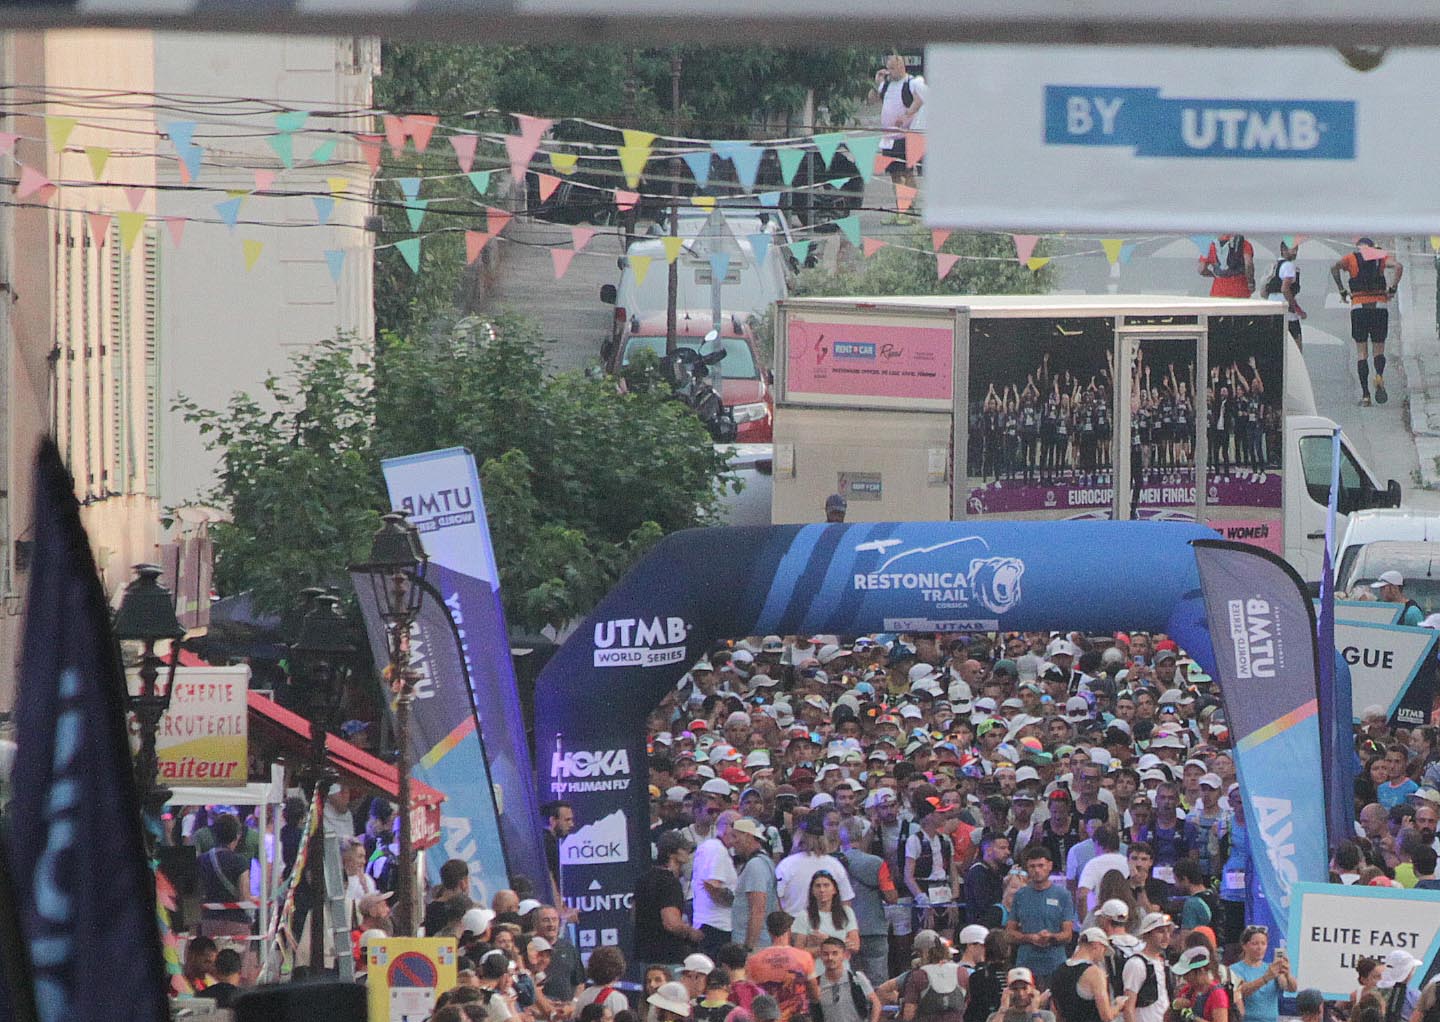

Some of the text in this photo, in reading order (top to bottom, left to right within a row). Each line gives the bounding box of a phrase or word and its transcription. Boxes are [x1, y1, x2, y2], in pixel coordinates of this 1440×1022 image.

[1065, 95, 1322, 151] BY UTMB
[1068, 488, 1114, 505] EUROCUP
[1162, 488, 1196, 504] FINALS
[853, 571, 968, 590] RESTONICA
[921, 589, 969, 602] TRAIL
[593, 615, 687, 649] UTMB
[893, 621, 912, 630] BY
[600, 650, 683, 663] WORLD SERIES
[157, 757, 238, 778] raiteur
[550, 749, 631, 778] HOKA
[568, 780, 613, 793] HUMAN
[613, 778, 631, 790] FLY
[567, 840, 621, 859] näak
[563, 892, 635, 912] UUNTO
[1311, 926, 1420, 949] ELITE FAST
